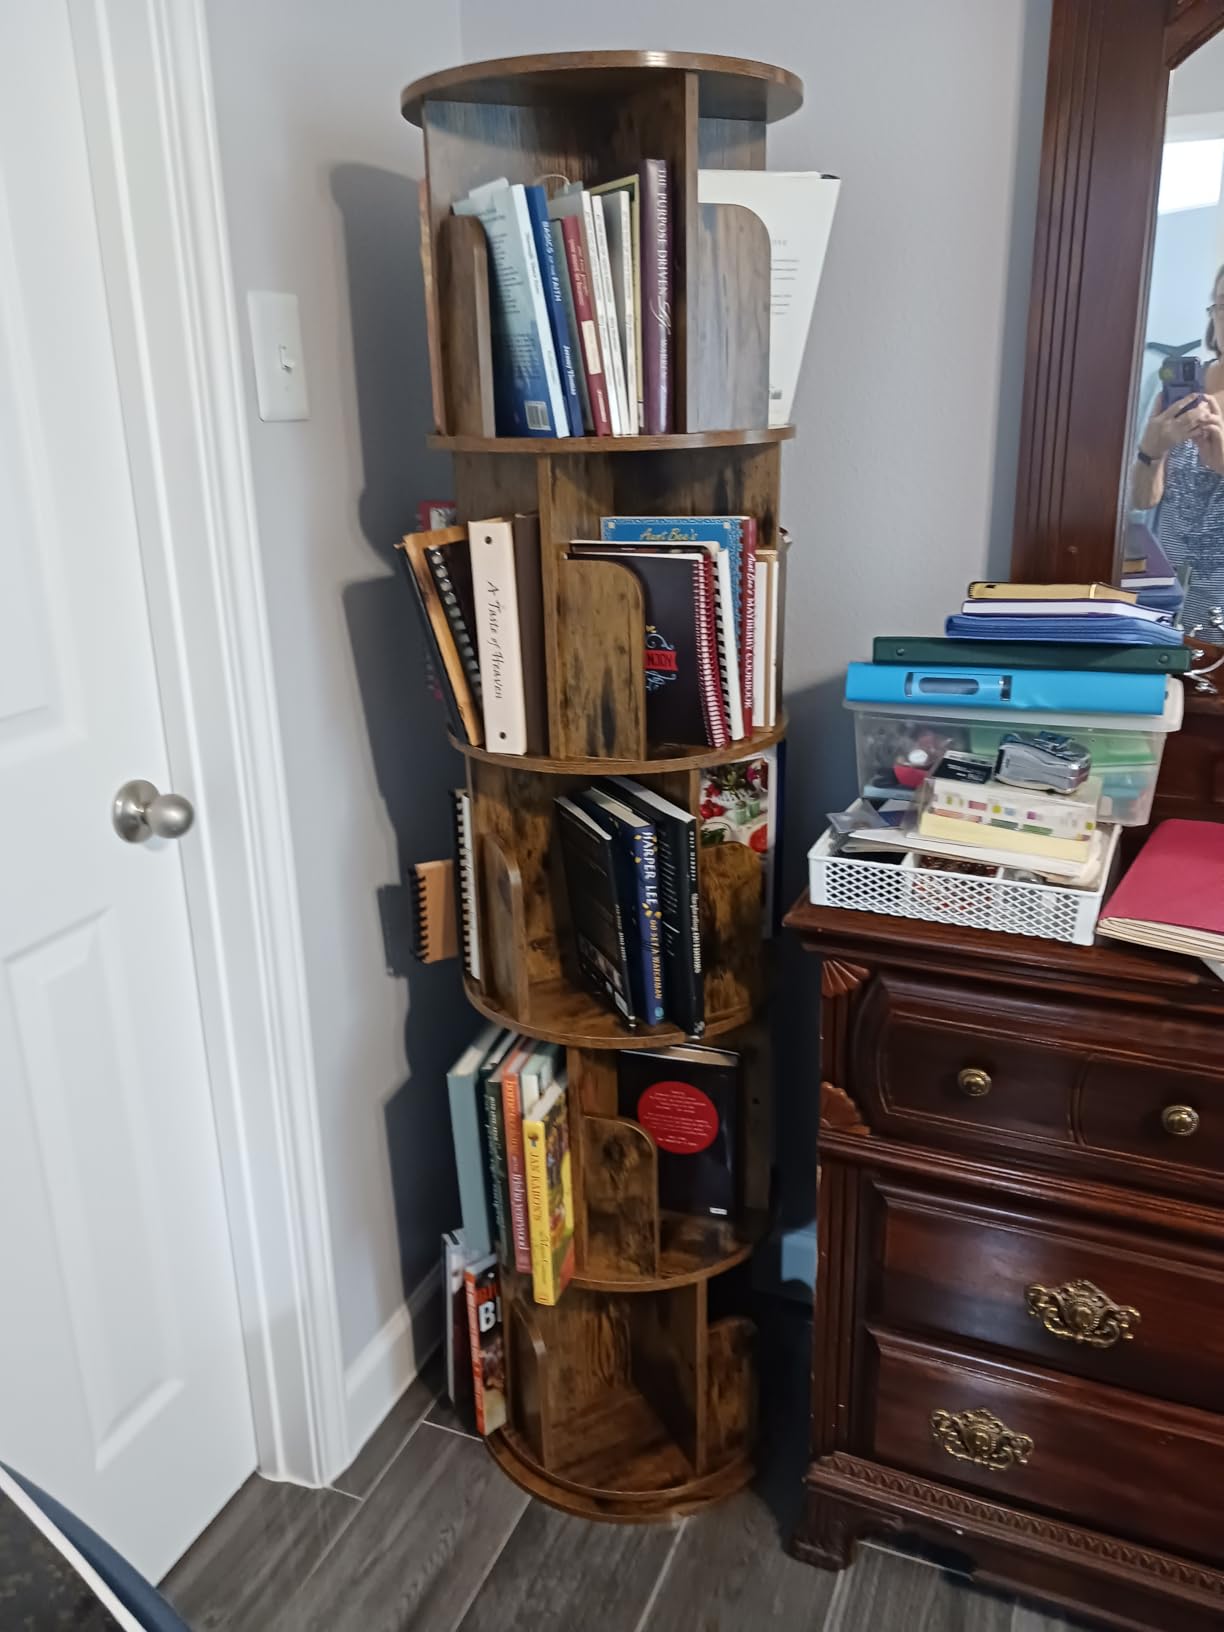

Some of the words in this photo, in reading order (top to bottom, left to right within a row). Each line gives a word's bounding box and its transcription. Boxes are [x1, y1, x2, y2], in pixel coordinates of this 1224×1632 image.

[657, 169, 668, 188] THE
[657, 193, 669, 244] PURPOSE
[542, 221, 555, 254] BASICS
[551, 276, 562, 302] FAITH
[658, 248, 671, 294] DRIVEN
[562, 345, 574, 369] Jeremy
[566, 369, 577, 396] Thomas
[667, 528, 699, 541] Bee's
[746, 553, 756, 572] Aunt
[487, 581, 500, 596] A
[746, 573, 755, 594] Bee's
[488, 600, 502, 634] Taste
[745, 597, 755, 651] MAYBERRY
[486, 638, 501, 650] of
[491, 652, 505, 699] Heaven
[744, 653, 753, 709] COOKBOOK
[642, 831, 657, 879] HARPER
[645, 885, 658, 905] LEE
[651, 956, 663, 999] WATCHMAN
[529, 1151, 539, 1172] JAN
[531, 1175, 543, 1222] KARON'S
